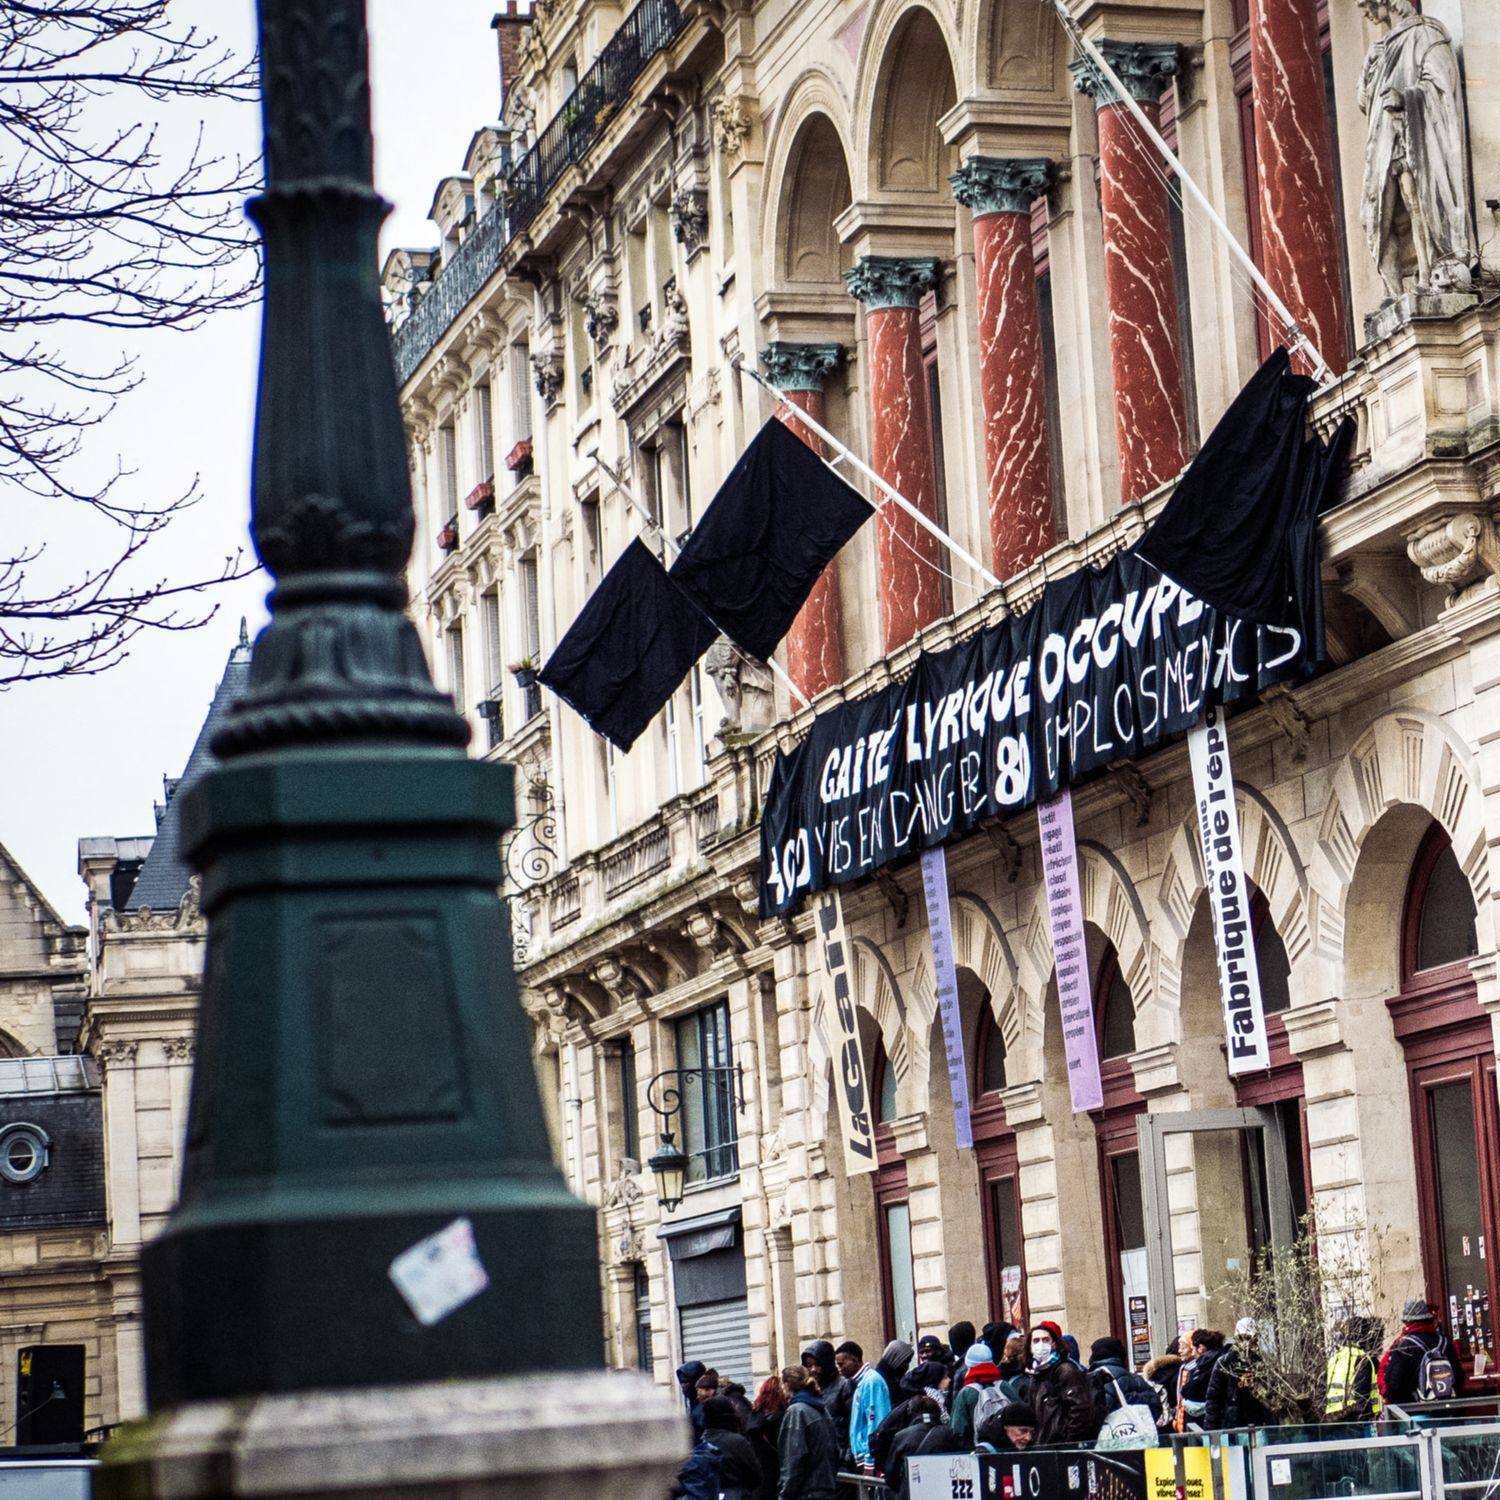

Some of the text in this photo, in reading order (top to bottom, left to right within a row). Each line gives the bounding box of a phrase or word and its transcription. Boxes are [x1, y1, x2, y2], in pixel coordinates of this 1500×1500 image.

[766, 828, 811, 905] 400
[858, 798, 883, 866] EN
[890, 751, 988, 847] DANGER
[994, 731, 1031, 808] 80
[1163, 619, 1302, 719] MENACS
[820, 709, 900, 804] GAÎTÉ
[906, 655, 1031, 764] LYRIQUE
[1213, 809, 1234, 863] de
[1219, 869, 1258, 1059] Fabrique
